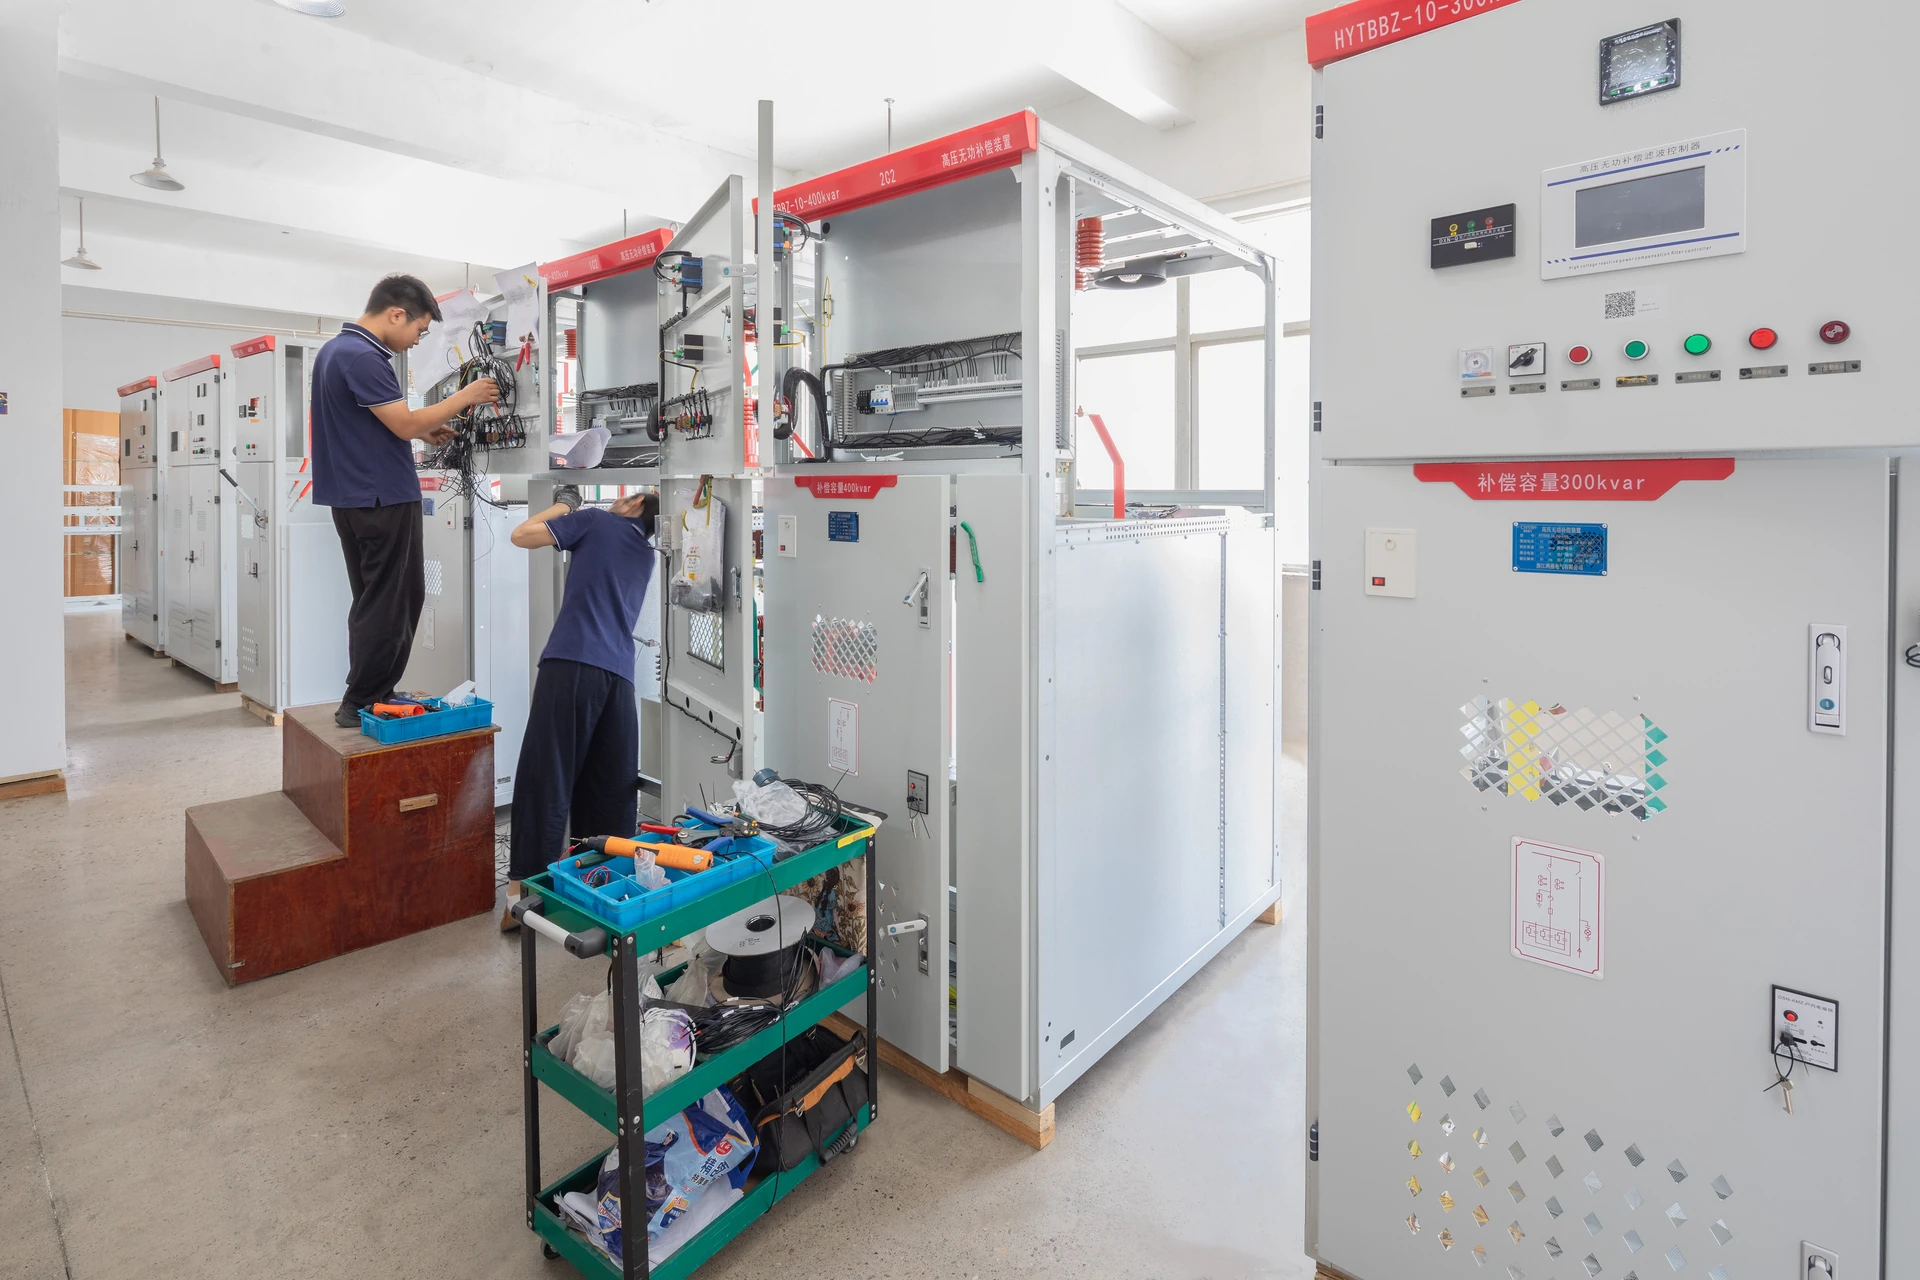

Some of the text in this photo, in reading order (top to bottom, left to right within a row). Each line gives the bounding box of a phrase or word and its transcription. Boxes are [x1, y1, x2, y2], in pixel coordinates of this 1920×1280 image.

[941, 134, 1013, 168] 高压无功补偿装置
[1579, 141, 1701, 173] 高压无功补偿滤波控制器
[1635, 252, 1671, 262] compensation
[1685, 246, 1712, 254] controller
[816, 481, 872, 494] 补偿容量400kvar
[1477, 472, 1645, 493] 补偿容量300kvar
